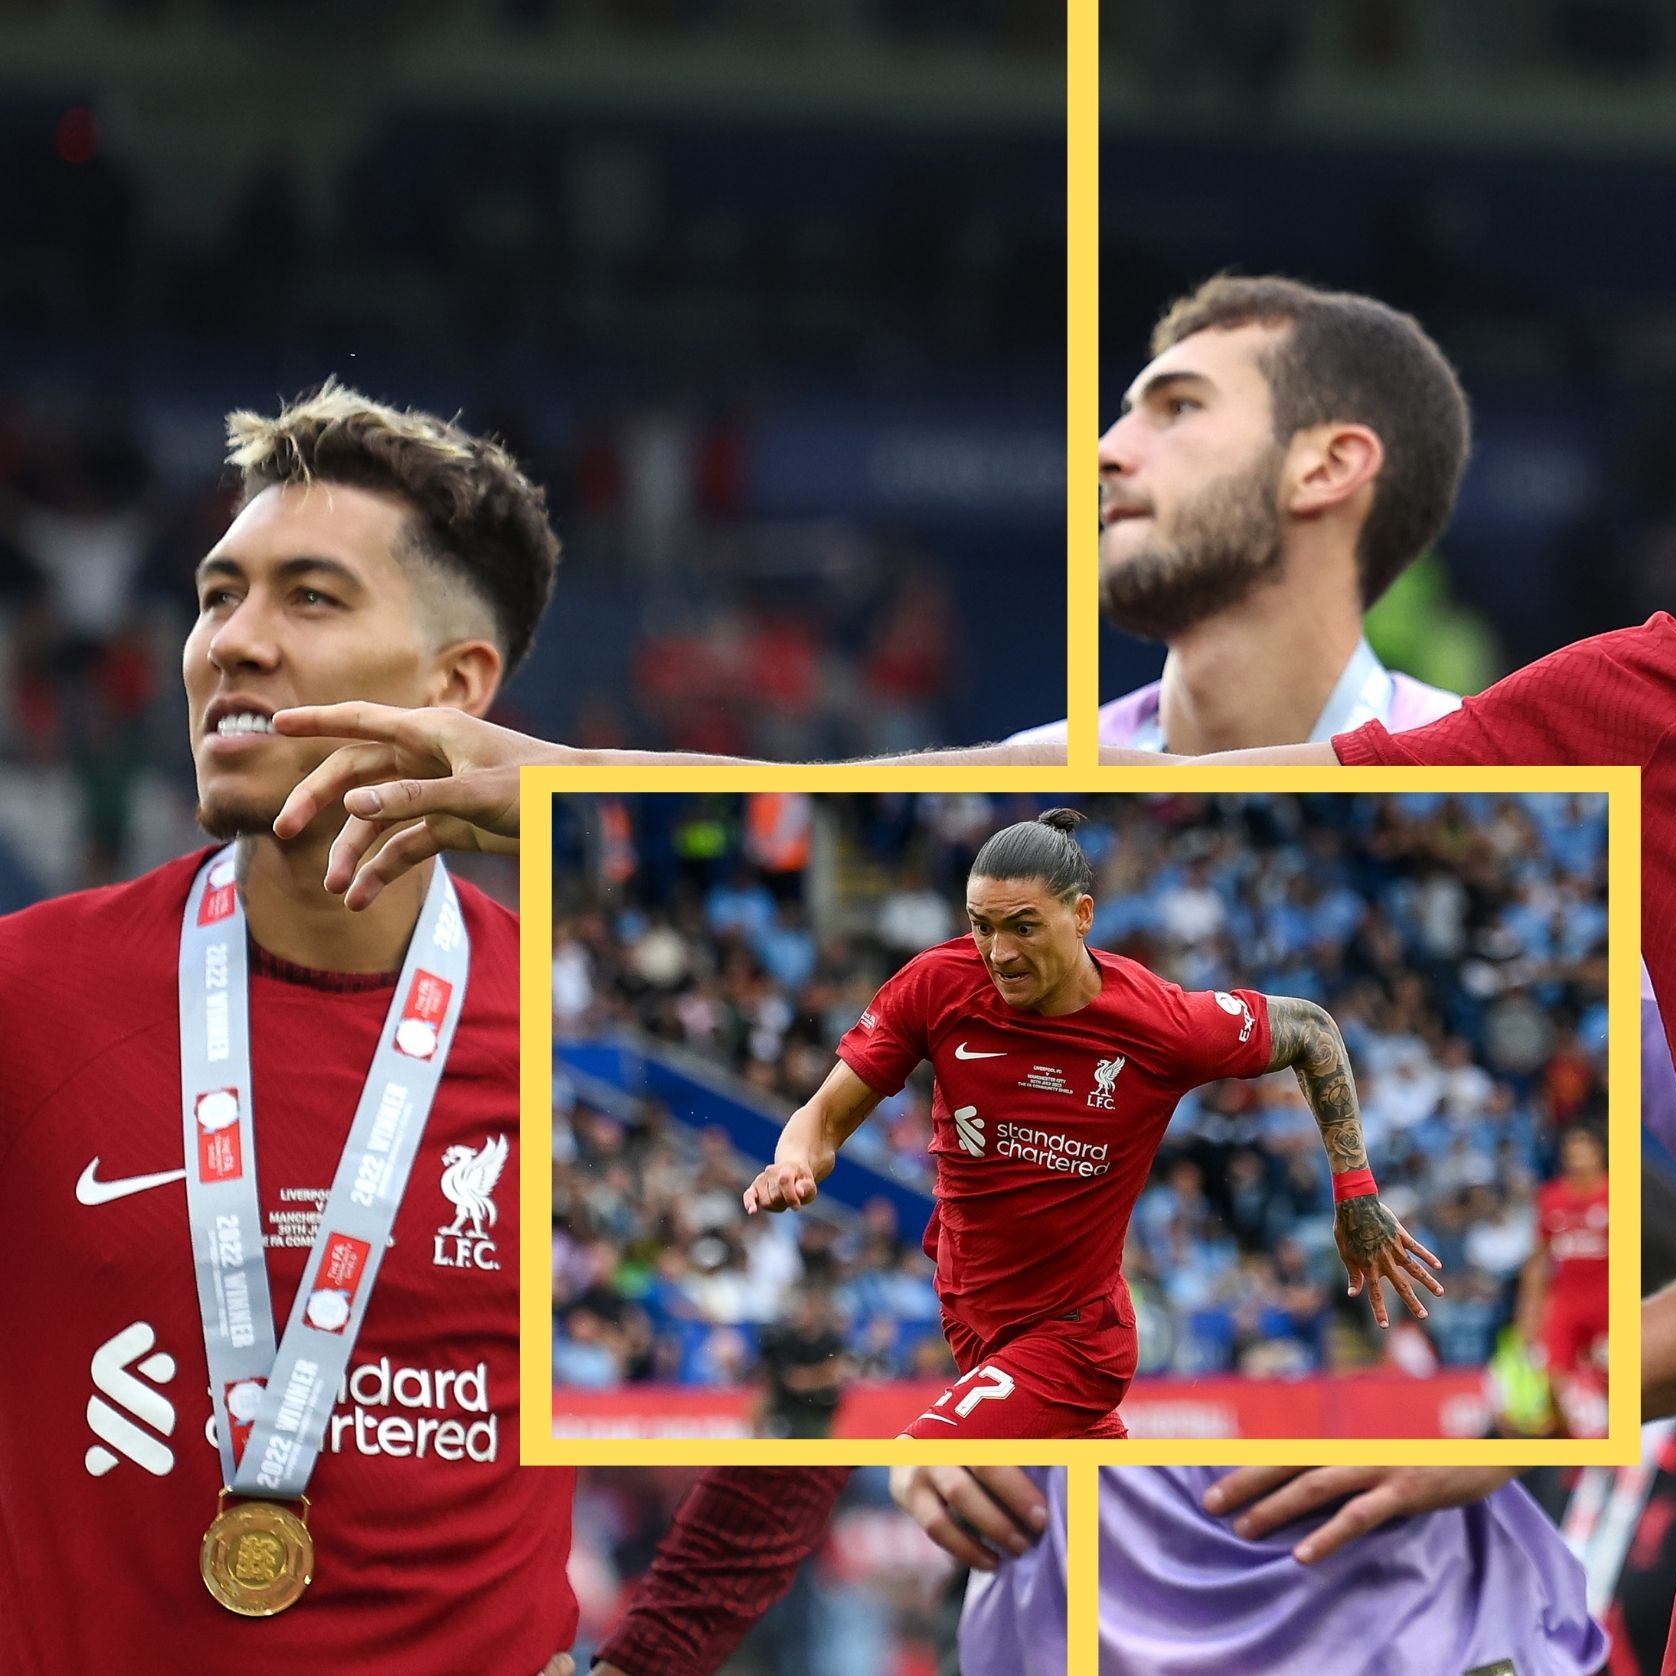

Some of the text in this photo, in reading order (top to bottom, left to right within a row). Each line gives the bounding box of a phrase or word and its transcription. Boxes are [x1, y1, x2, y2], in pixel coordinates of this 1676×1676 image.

[367, 1081, 408, 1153] WINNER
[1086, 1095, 1116, 1110] L.F.C.
[997, 1122, 1108, 1160] standard
[997, 1139, 1110, 1177] chartered
[280, 1188, 331, 1201] LIVERPO
[350, 1153, 385, 1208] 2022
[216, 1214, 243, 1270] 2022
[432, 1235, 501, 1271] L.F.C.
[223, 1271, 255, 1349] WINNER
[257, 1435, 293, 1490] 2022
[275, 1359, 320, 1433] WINNER
